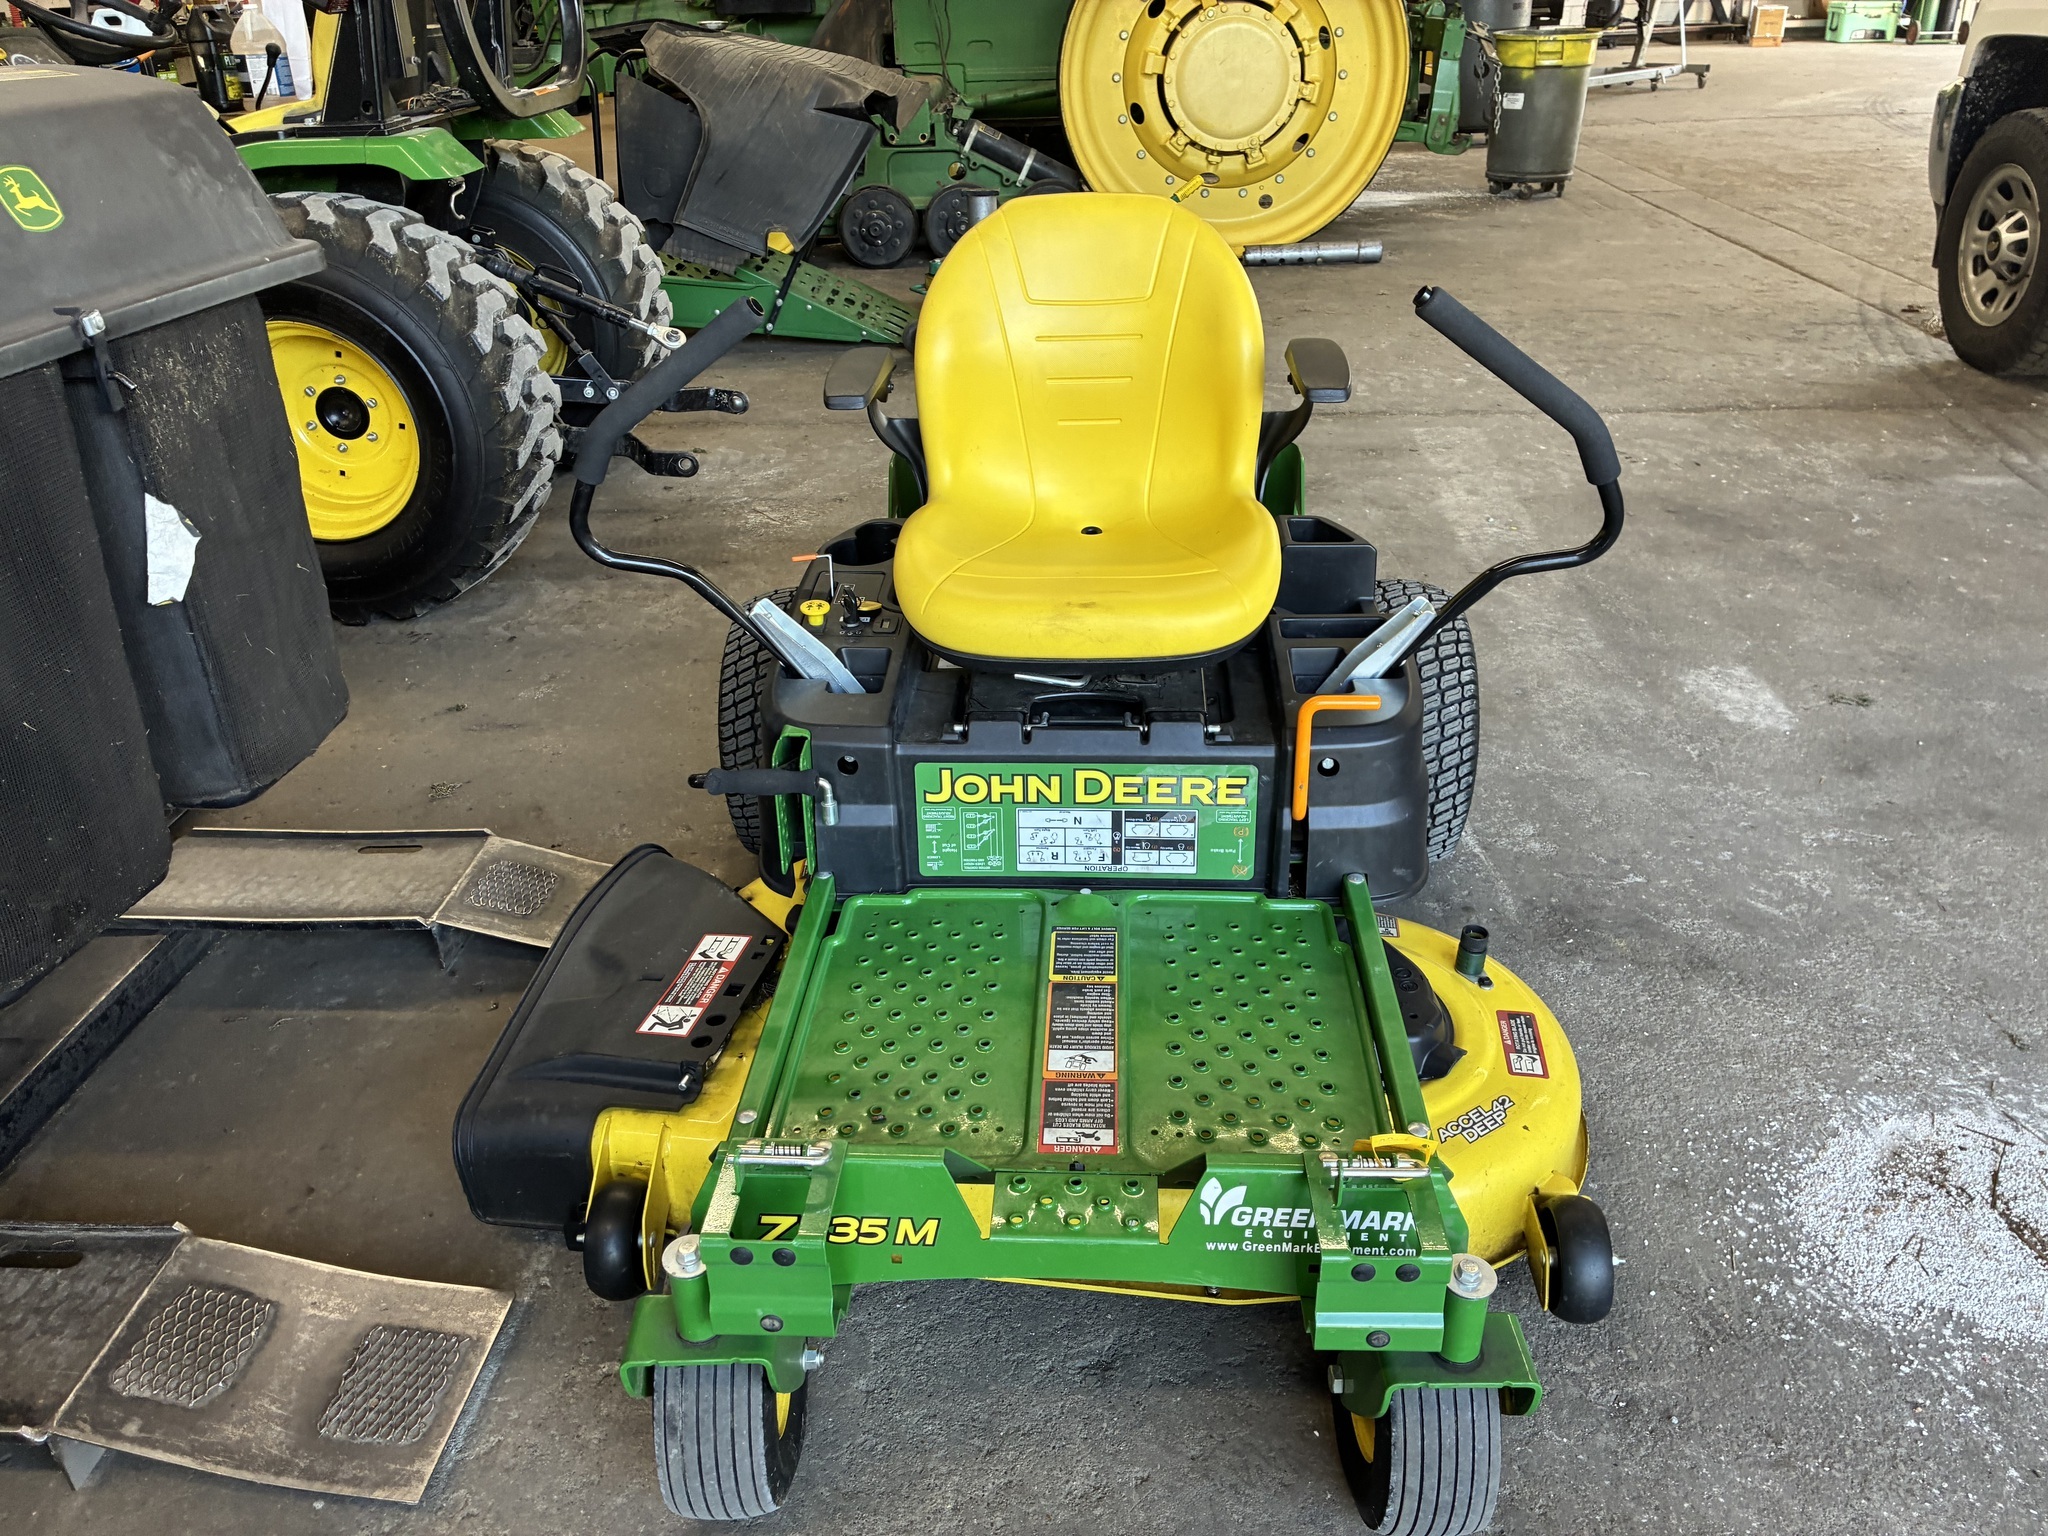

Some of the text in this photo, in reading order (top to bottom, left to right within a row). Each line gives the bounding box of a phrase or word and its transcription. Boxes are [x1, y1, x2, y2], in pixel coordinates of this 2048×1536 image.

[924, 768, 1250, 806] JOHN DEERE
[1074, 816, 1082, 825] N
[1051, 852, 1058, 861] R
[1098, 853, 1106, 862] F
[700, 974, 726, 1004] DANGER
[1500, 1020, 1510, 1040] DANGER
[1437, 1105, 1493, 1144] ACCEL
[1460, 1110, 1507, 1144] DEEP
[1054, 1145, 1090, 1153] DANGER
[1231, 1207, 1417, 1231] GREEMAR
[1245, 1229, 1408, 1242] EQUIENT
